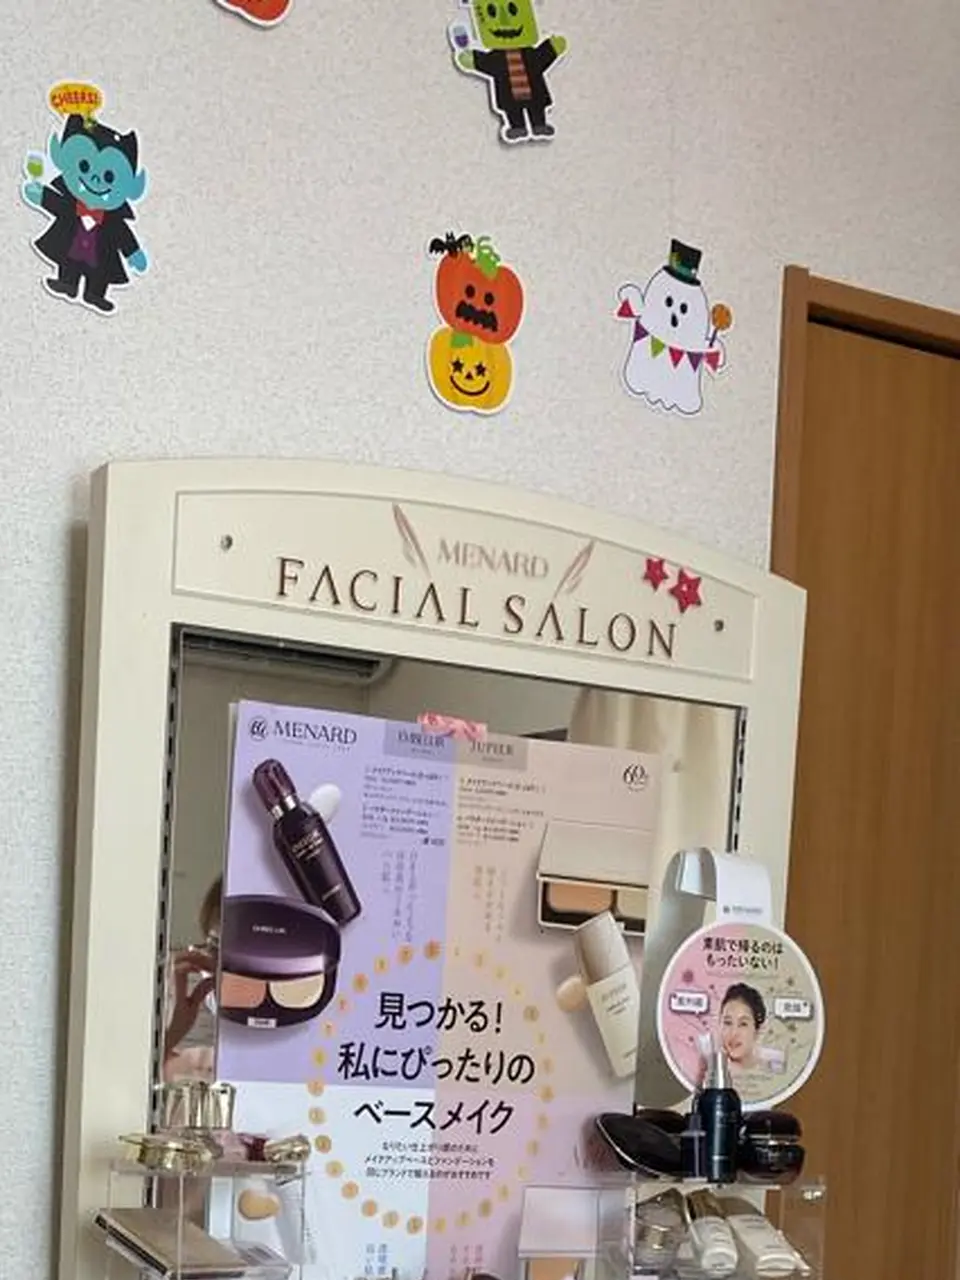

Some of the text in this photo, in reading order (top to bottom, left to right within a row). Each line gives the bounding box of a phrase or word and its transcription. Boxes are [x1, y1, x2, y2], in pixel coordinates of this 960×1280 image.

[437, 538, 549, 578] MENARD
[276, 556, 677, 659] FACIAL SALON
[273, 719, 358, 745] MENARD
[702, 937, 783, 955] 素肌で帰るのは
[338, 1041, 535, 1086] 私にぴったりの
[354, 1099, 515, 1135] ベースメイク
